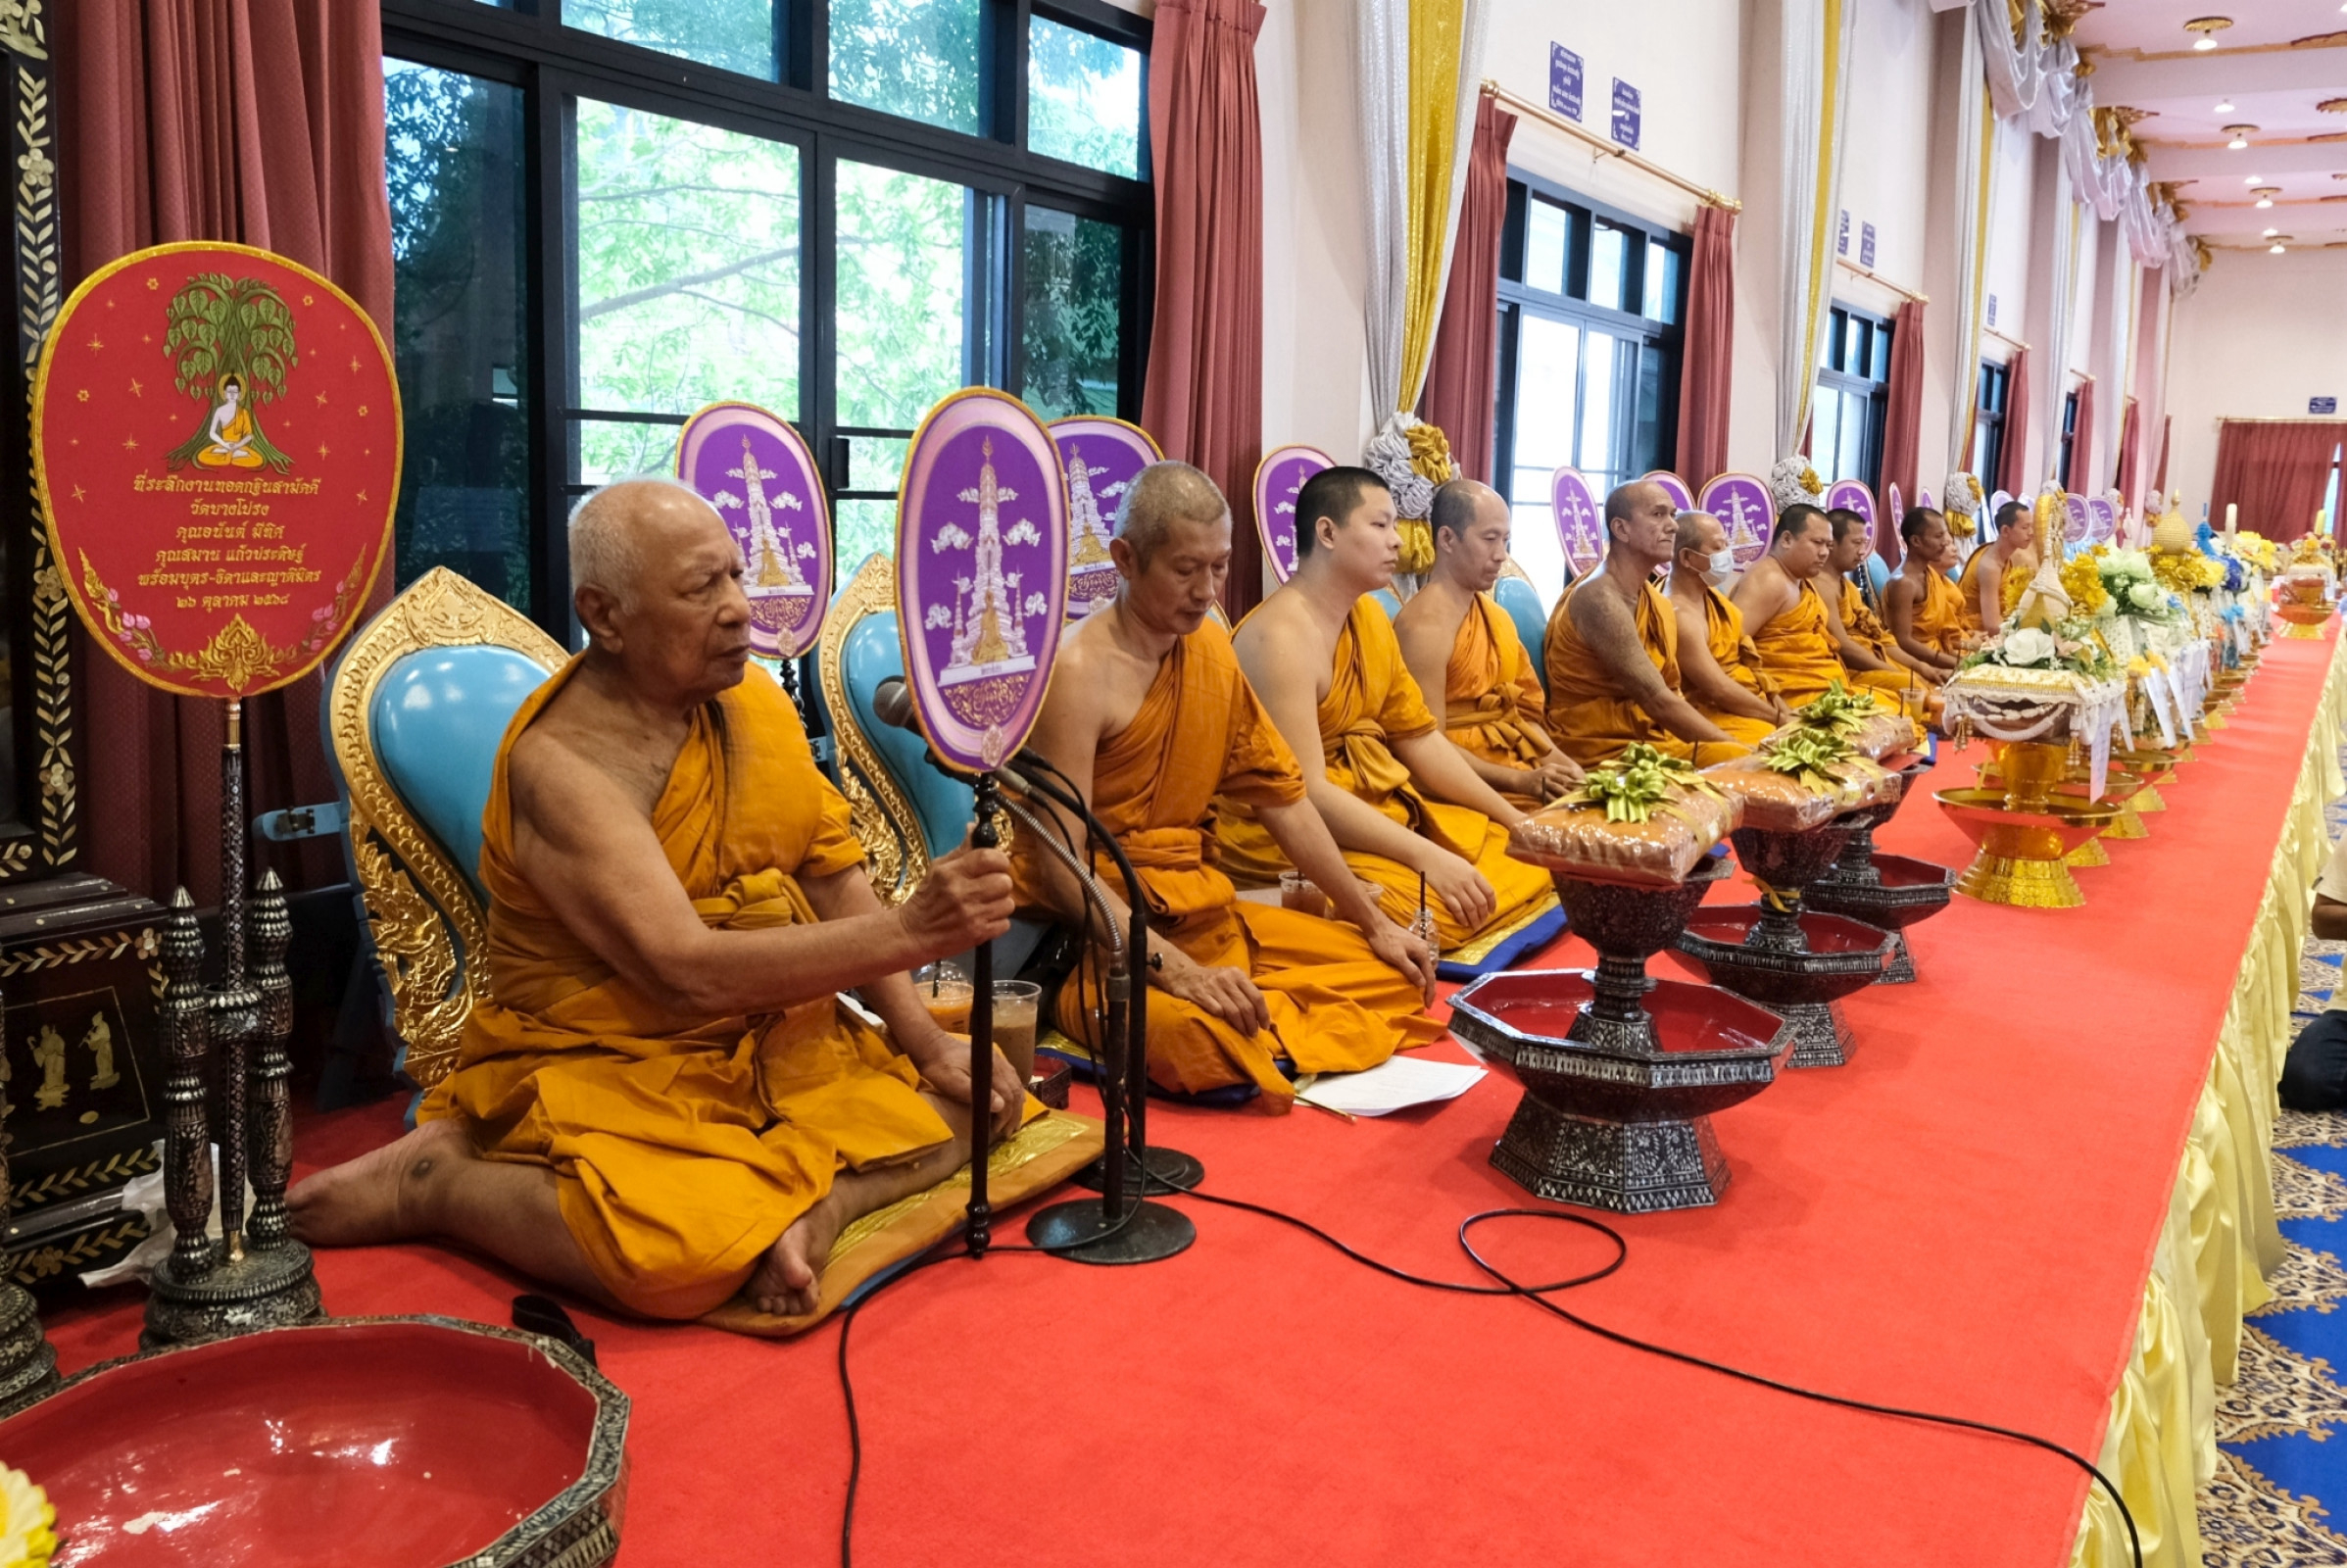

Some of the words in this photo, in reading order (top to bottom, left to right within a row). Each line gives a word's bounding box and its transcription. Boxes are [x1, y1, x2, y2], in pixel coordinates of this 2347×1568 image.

[190, 498, 269, 516] วัดบางโปรง
[175, 520, 249, 544] คุณอนันต์
[155, 548, 221, 567] คุณสมาน
[225, 543, 307, 564] แก้วประดิษฐ์
[175, 596, 197, 609] ๒๖
[202, 594, 250, 613] ตุลาคม
[253, 593, 290, 606] ๒๕๖๘
